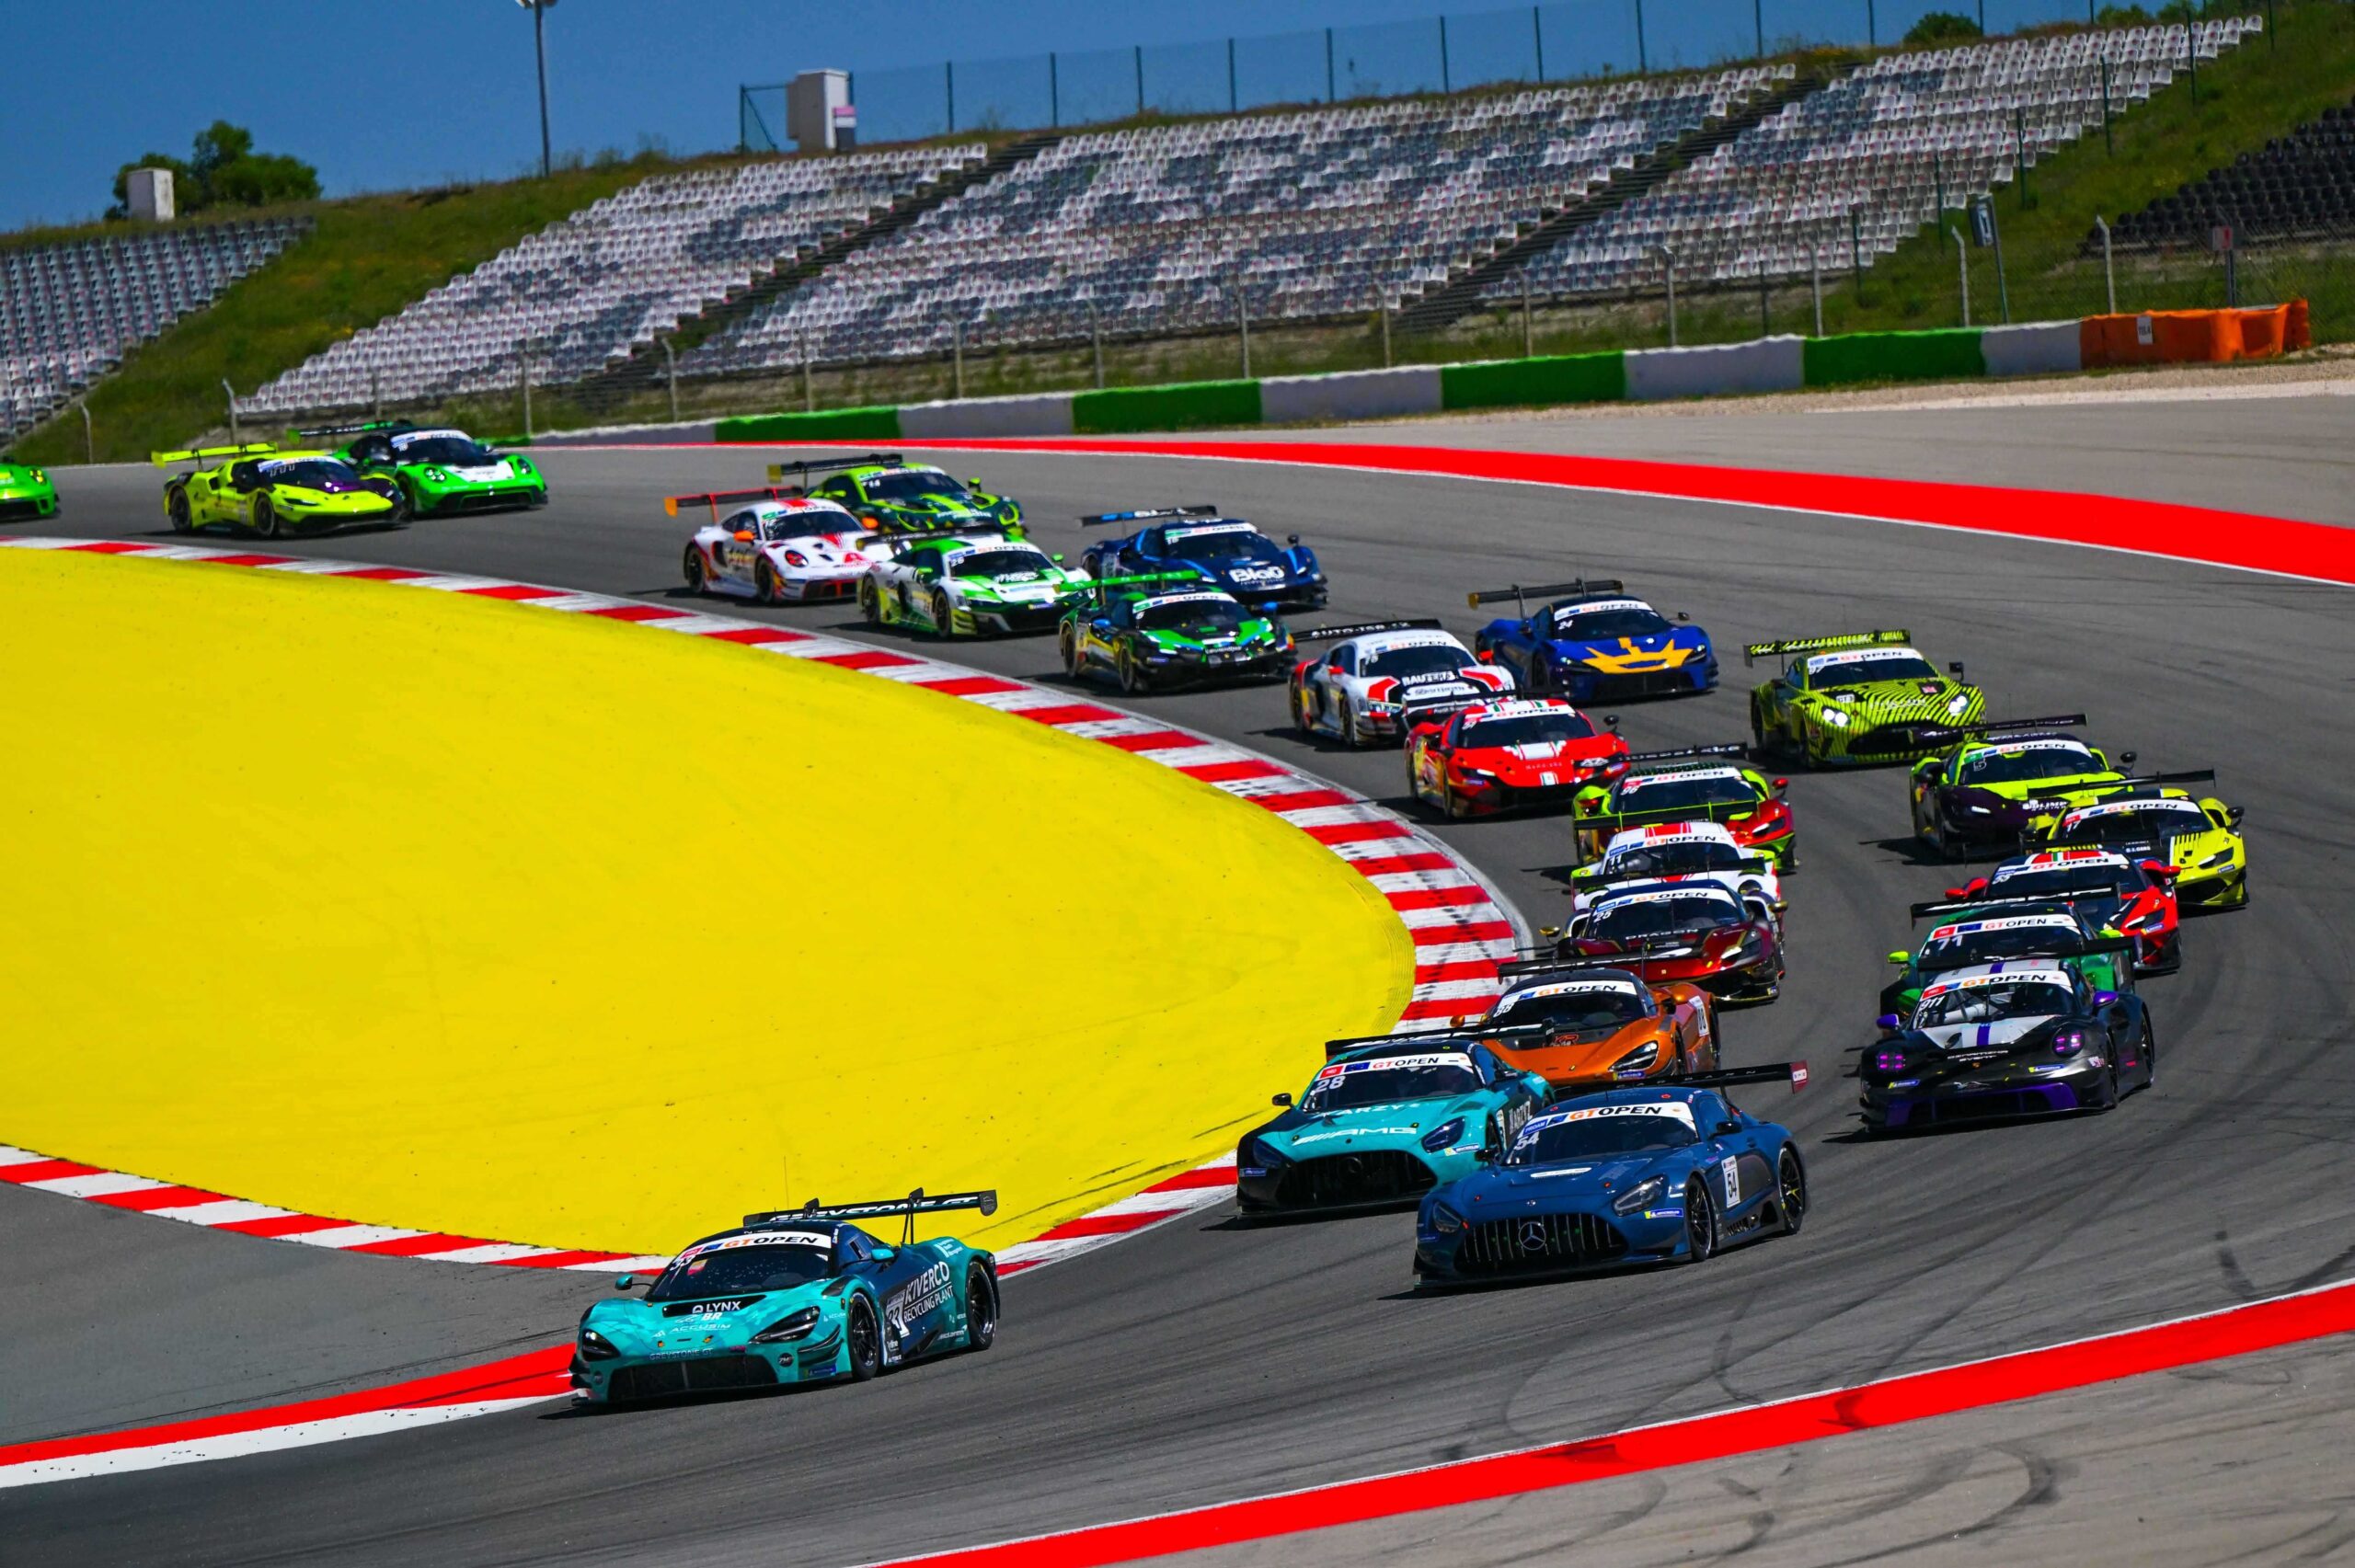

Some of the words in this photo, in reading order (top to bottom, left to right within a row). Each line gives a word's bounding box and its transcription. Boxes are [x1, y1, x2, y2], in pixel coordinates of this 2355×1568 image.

[1937, 935, 1963, 950] 71
[1920, 996, 1946, 1012] 911
[1315, 1075, 1346, 1093] 28
[1336, 1127, 1417, 1137] AMG
[1513, 1131, 1540, 1150] 54
[1727, 1171, 1738, 1198] 54
[904, 1261, 950, 1305] KIVERCO
[706, 1300, 741, 1312] LYNX
[903, 1295, 936, 1322] RECYCLING
[935, 1285, 955, 1306] PLANT
[649, 1350, 700, 1360] GREYSTONE
